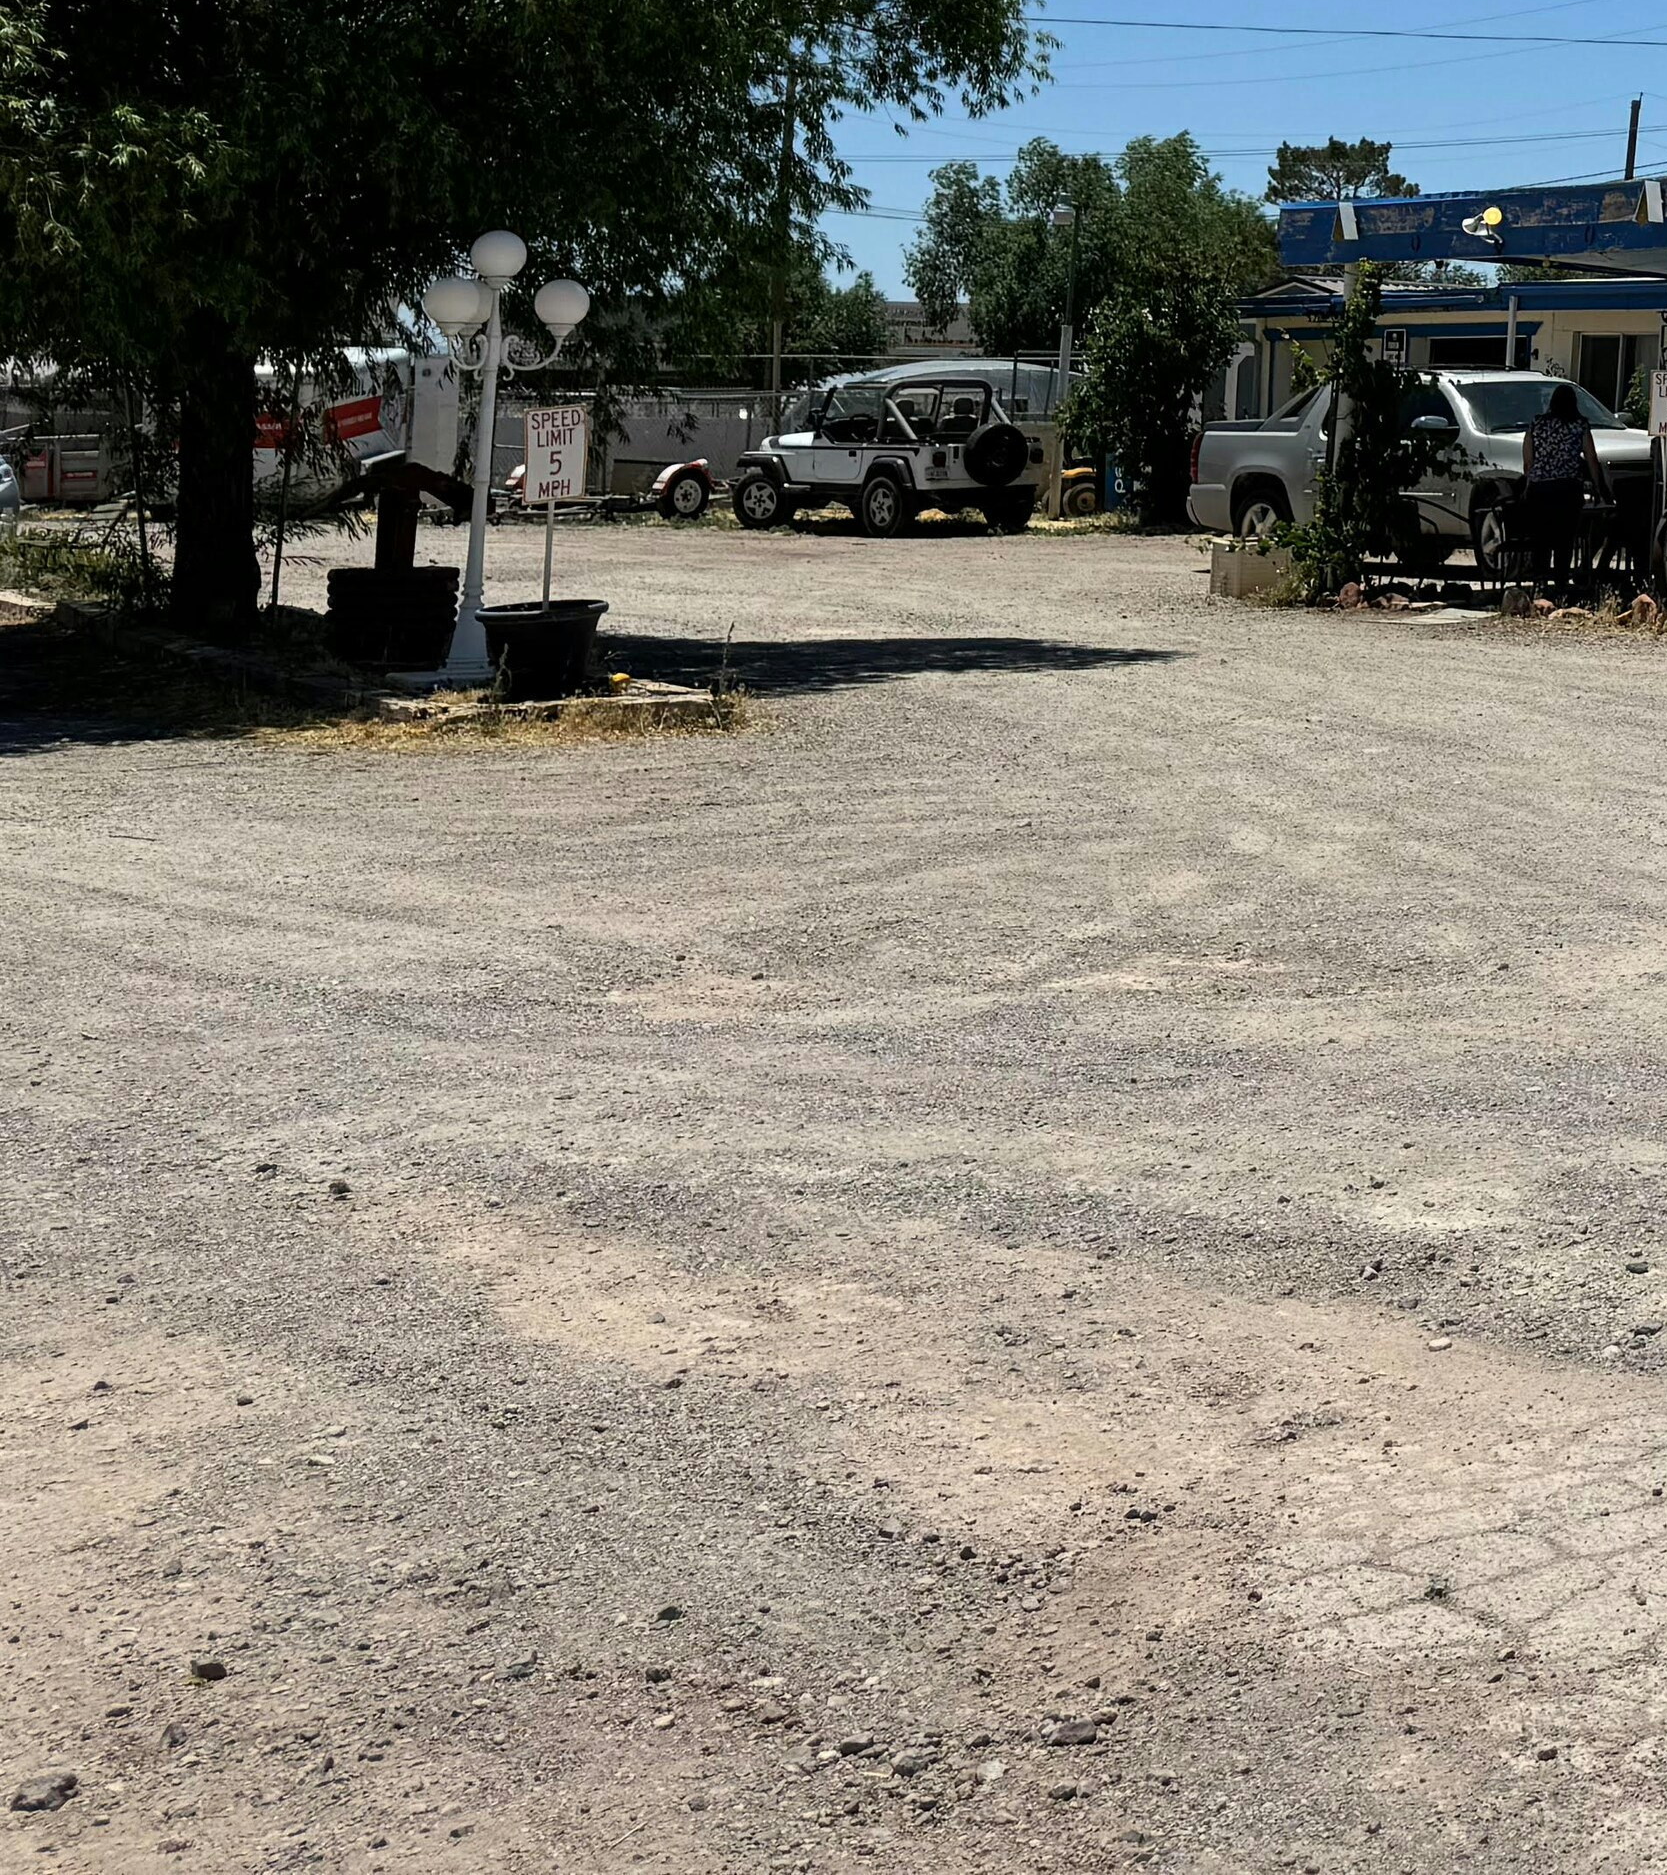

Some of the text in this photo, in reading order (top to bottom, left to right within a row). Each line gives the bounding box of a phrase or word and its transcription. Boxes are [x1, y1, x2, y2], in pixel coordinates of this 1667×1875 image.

[531, 409, 580, 430] SPEED
[537, 428, 576, 447] LIMIT
[549, 451, 562, 476] 5
[538, 479, 570, 499] MPH
